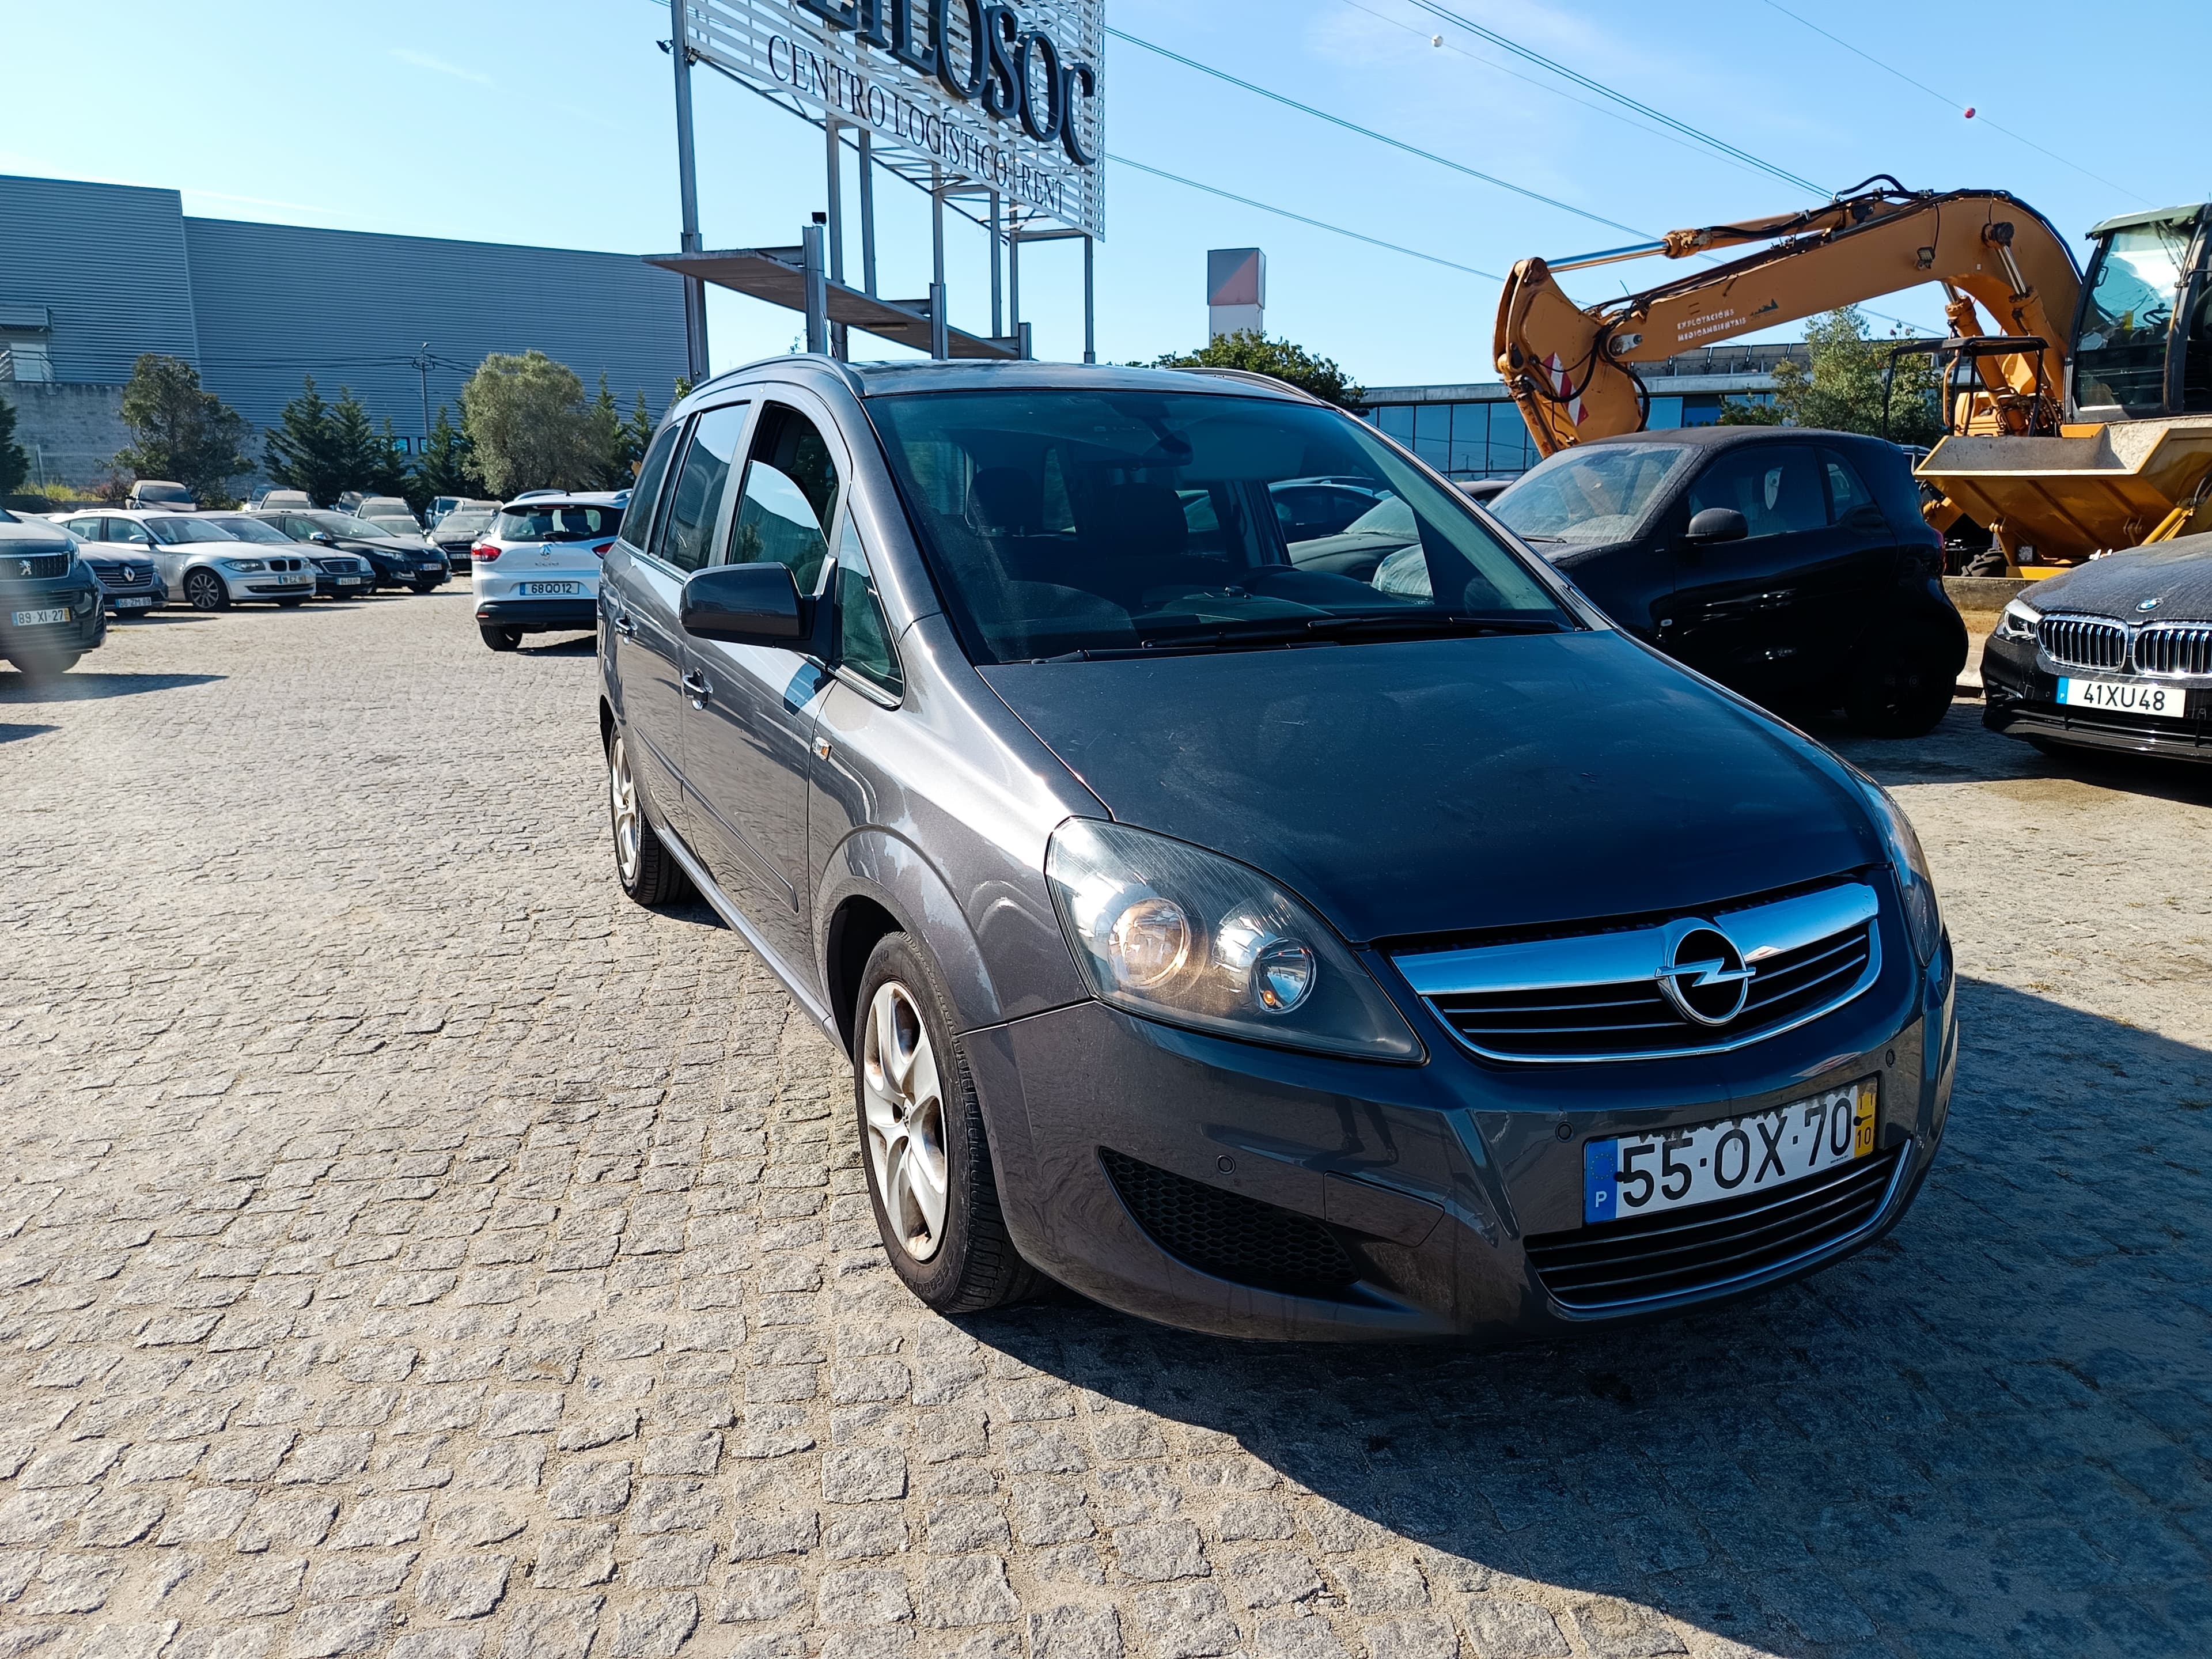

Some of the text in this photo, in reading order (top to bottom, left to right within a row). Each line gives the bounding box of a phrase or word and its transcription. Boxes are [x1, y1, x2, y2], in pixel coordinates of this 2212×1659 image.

[768, 35, 885, 127] CENTRO
[1021, 163, 1065, 214] RENT
[1857, 1126, 1872, 1148] 10
[1595, 1190, 1607, 1208] P
